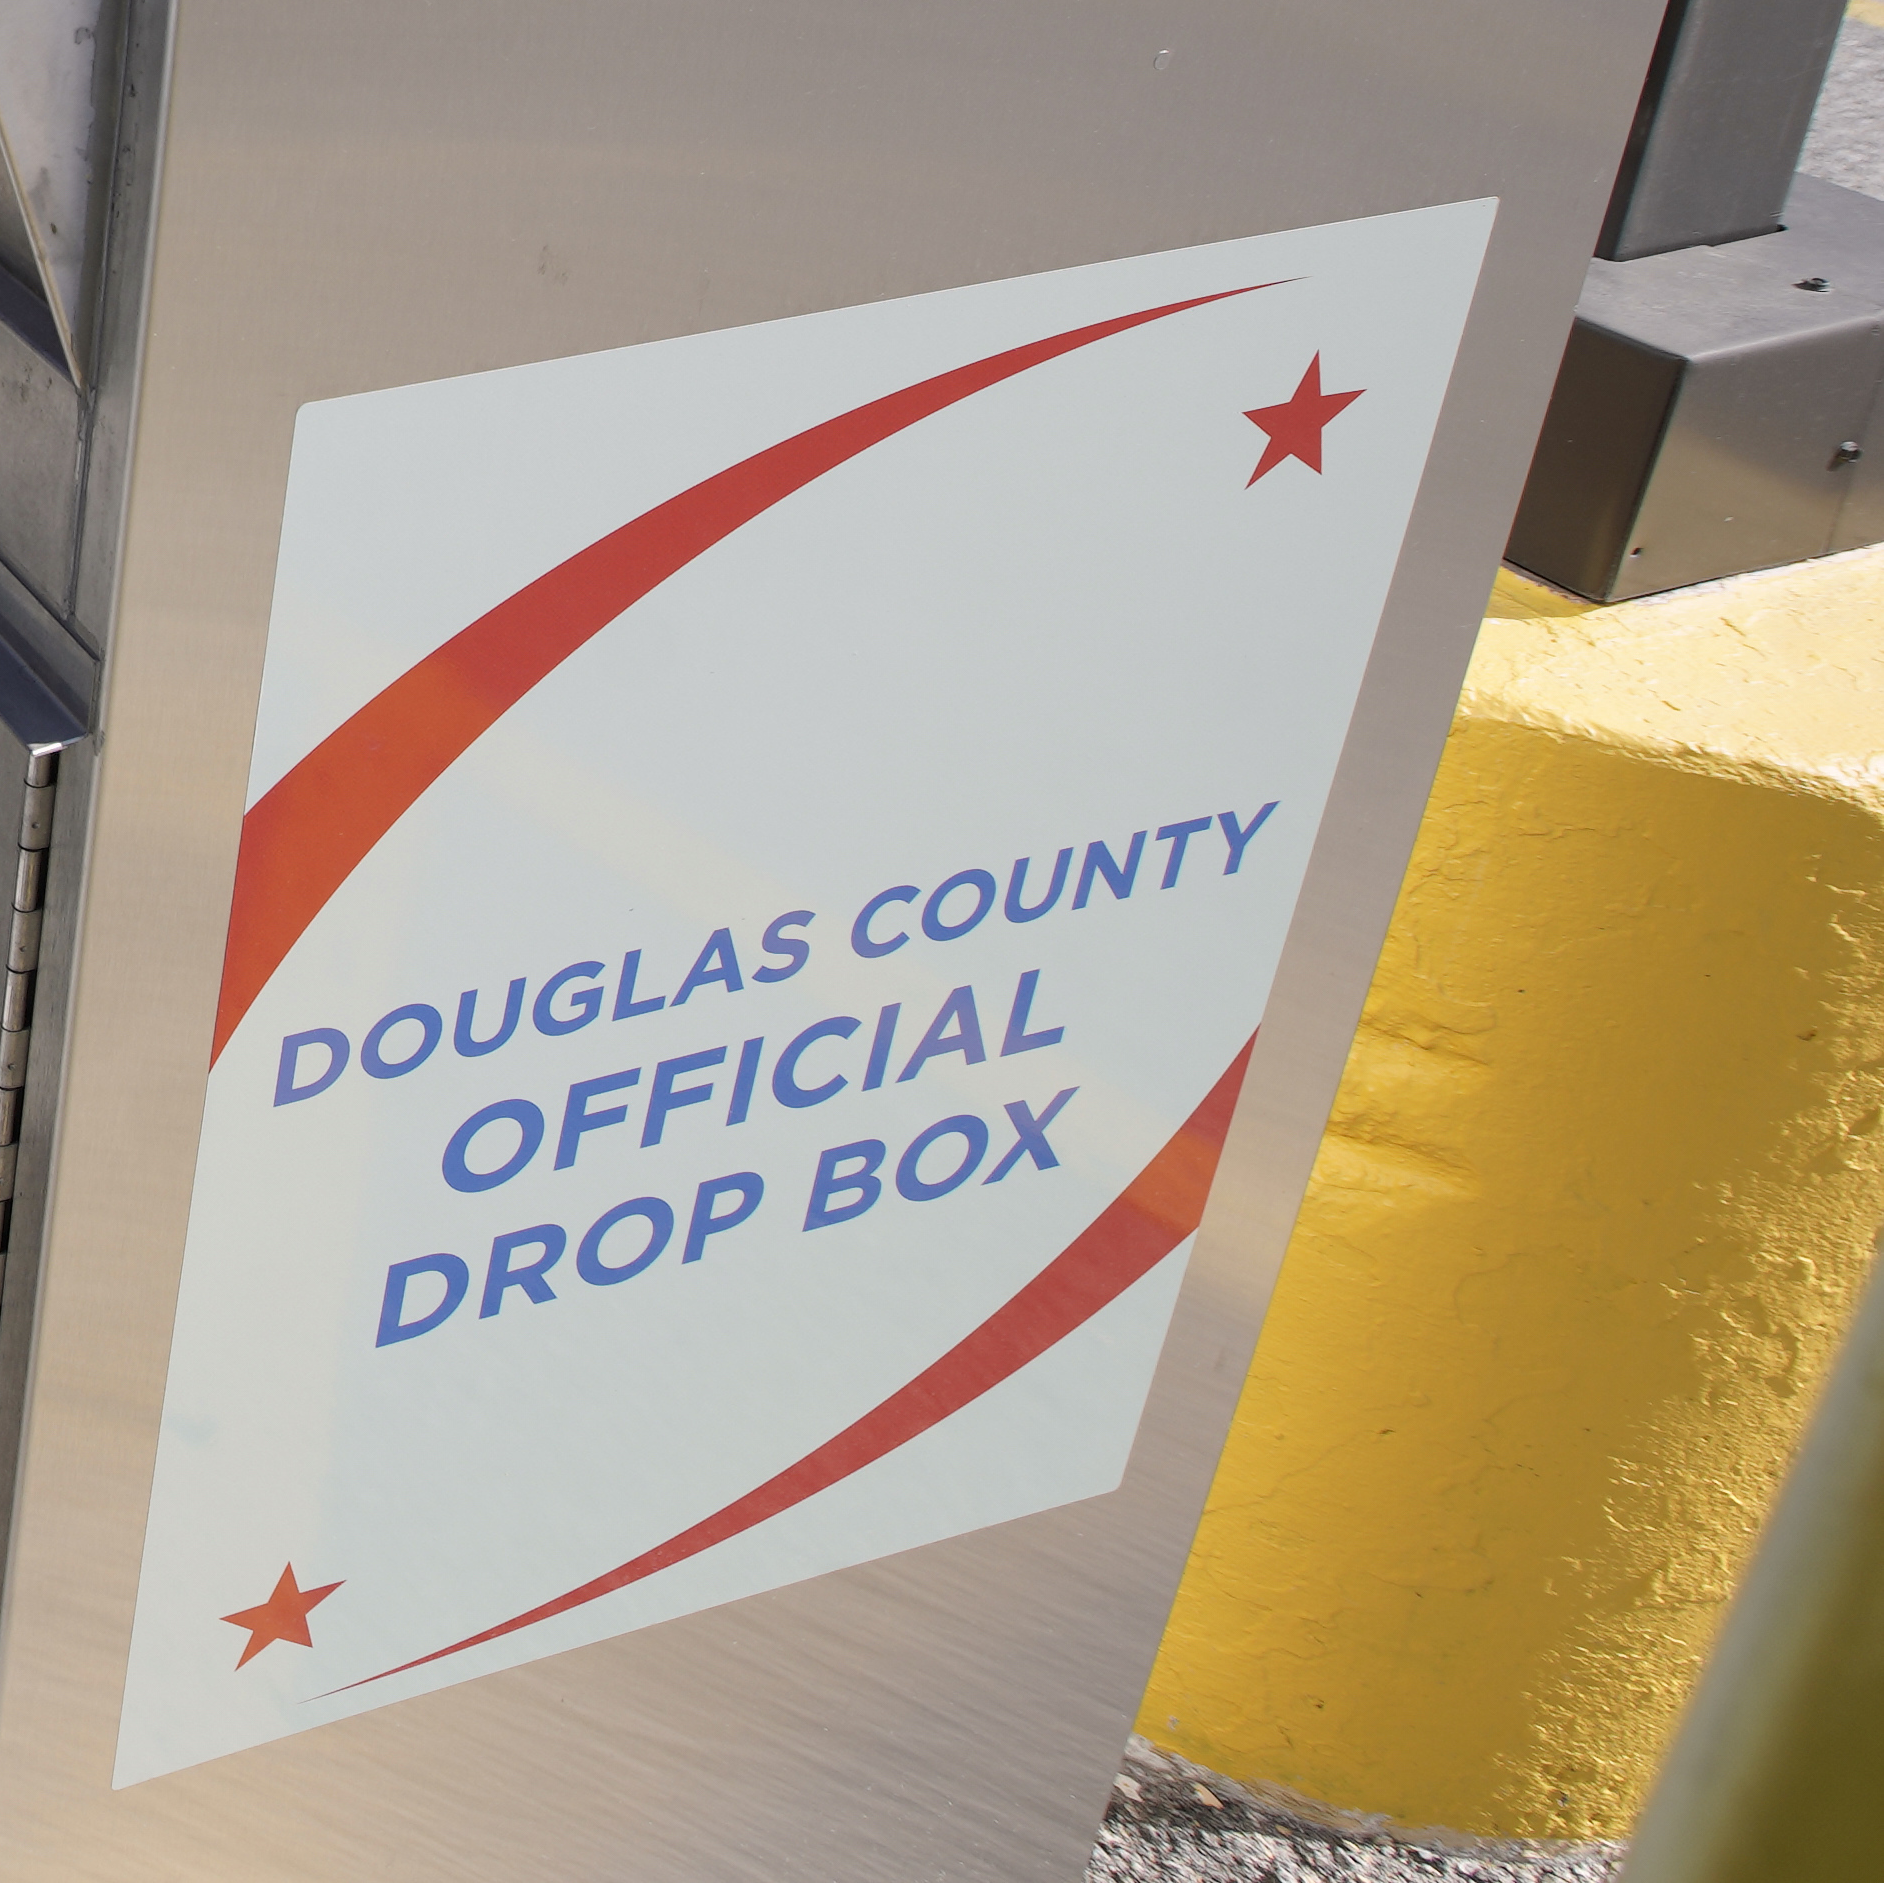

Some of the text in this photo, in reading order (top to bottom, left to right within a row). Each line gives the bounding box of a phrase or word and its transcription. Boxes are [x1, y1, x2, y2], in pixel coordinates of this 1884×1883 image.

[272, 799, 1281, 1108] DOUGLAS COUNTY
[440, 968, 1066, 1195] OFFICIAL
[374, 1085, 1081, 1349] DROP BOX
